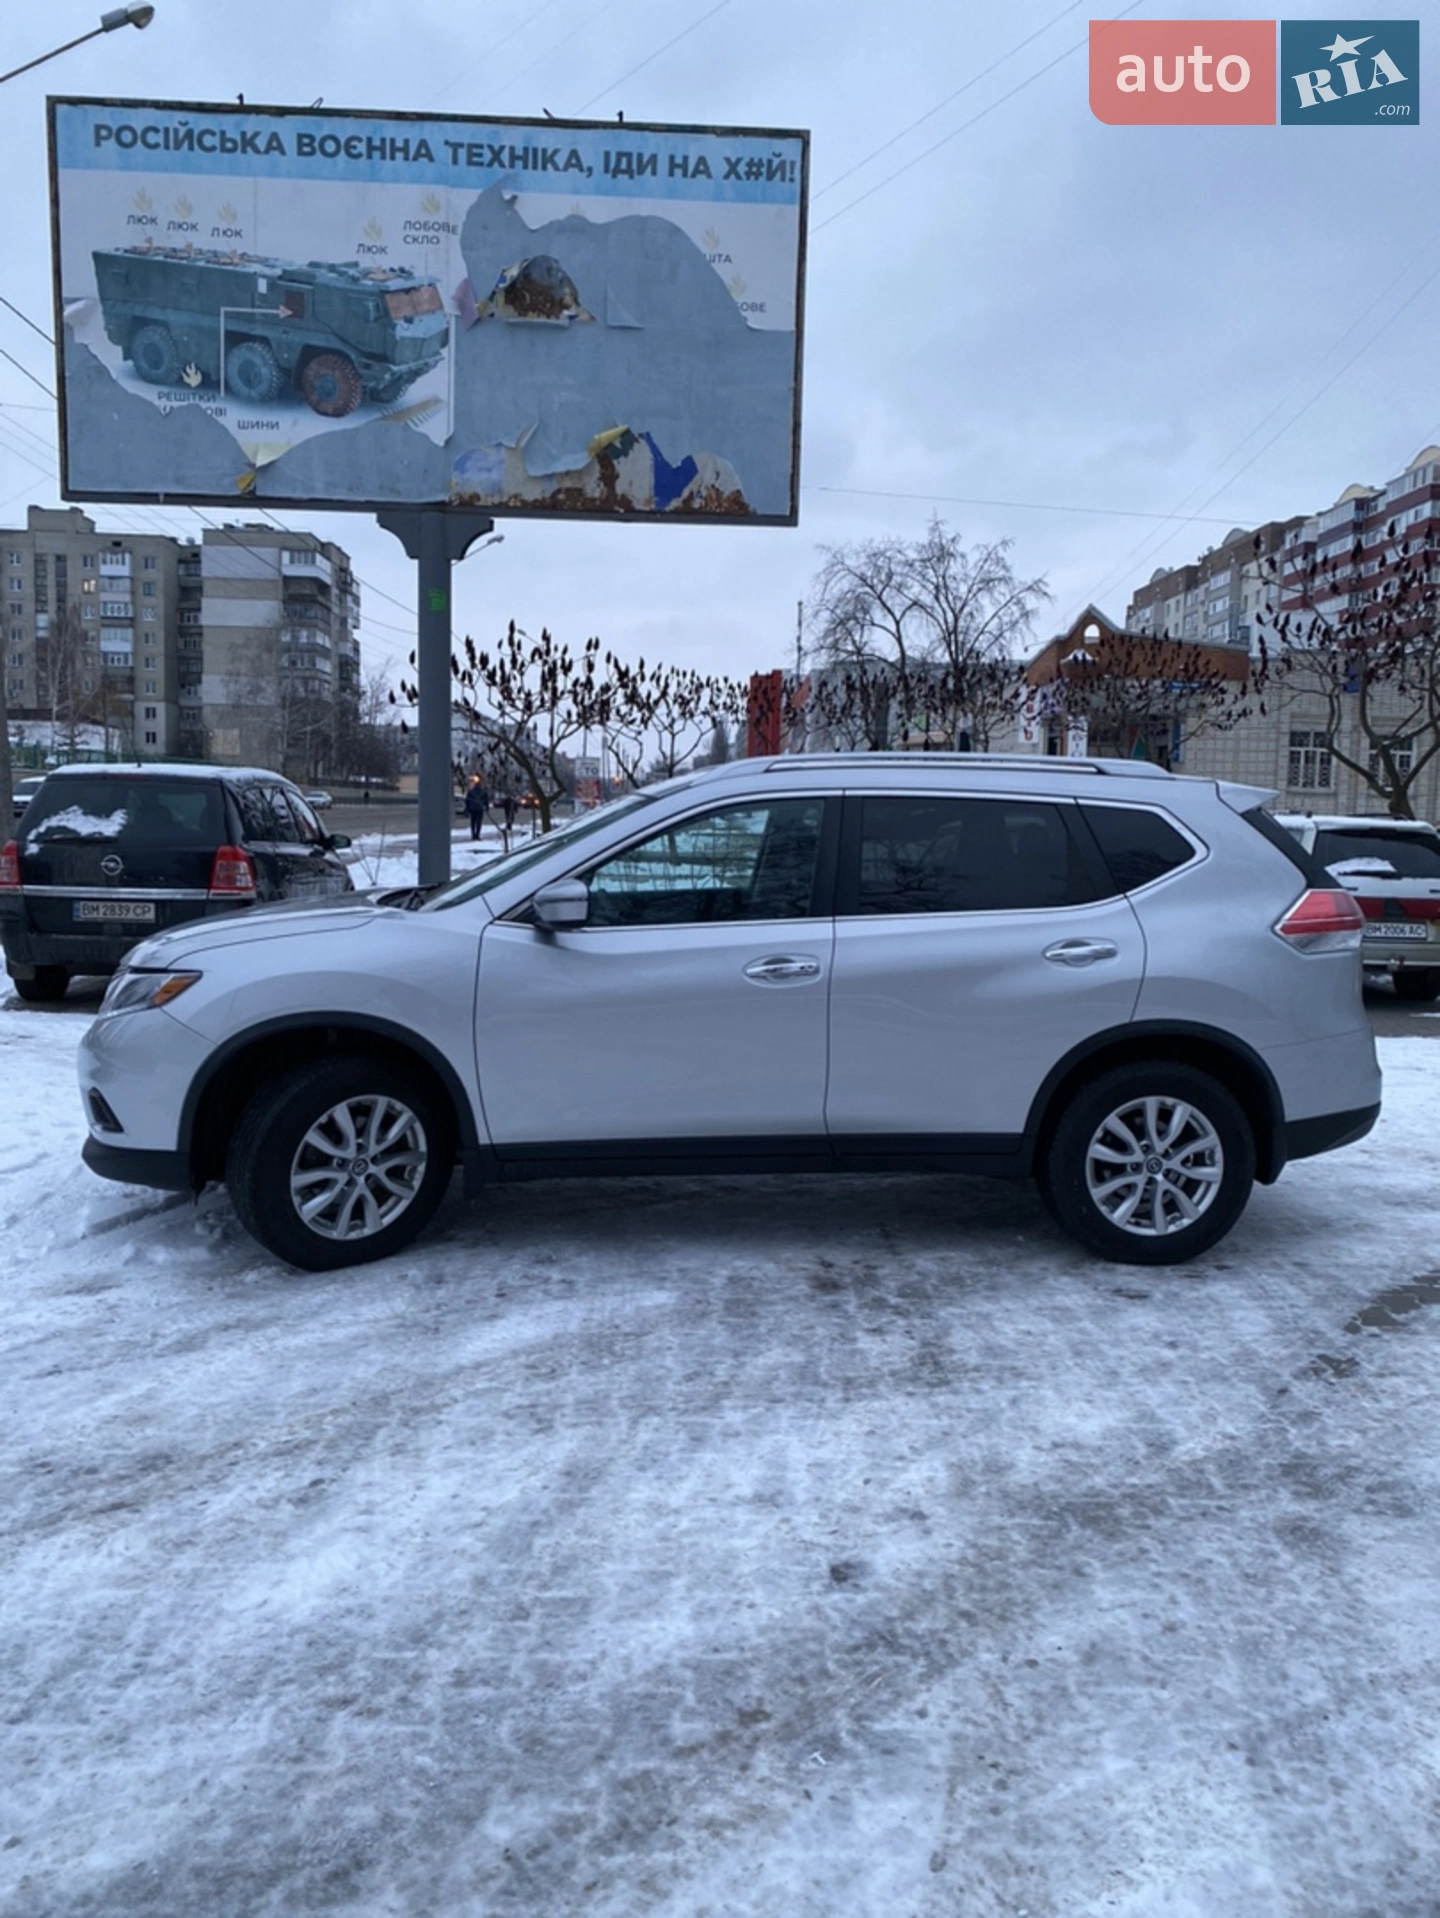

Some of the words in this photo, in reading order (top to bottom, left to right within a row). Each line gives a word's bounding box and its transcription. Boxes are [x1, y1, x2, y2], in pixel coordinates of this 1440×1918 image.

[93, 120, 287, 156] РОСІЙСЬКА
[295, 132, 435, 163] ВОЄННА
[443, 139, 594, 178] ТЕХНІКА,
[603, 151, 658, 179] ІДИ
[668, 153, 714, 180] НА
[722, 151, 797, 184] Х#Й!
[126, 214, 159, 226] ЛЮК
[166, 220, 199, 233] ЛЮК
[210, 226, 243, 239] ЛЮК
[403, 219, 460, 236] ЛОБОВЕ
[403, 234, 441, 246] СКЛО
[356, 242, 388, 255] ЛЮК
[703, 252, 733, 264] ШТА
[738, 300, 768, 313] ОВЕ
[157, 390, 216, 403] РЕШІТКИ
[237, 418, 280, 431] ШИНИ
[102, 903, 131, 917] 2839
